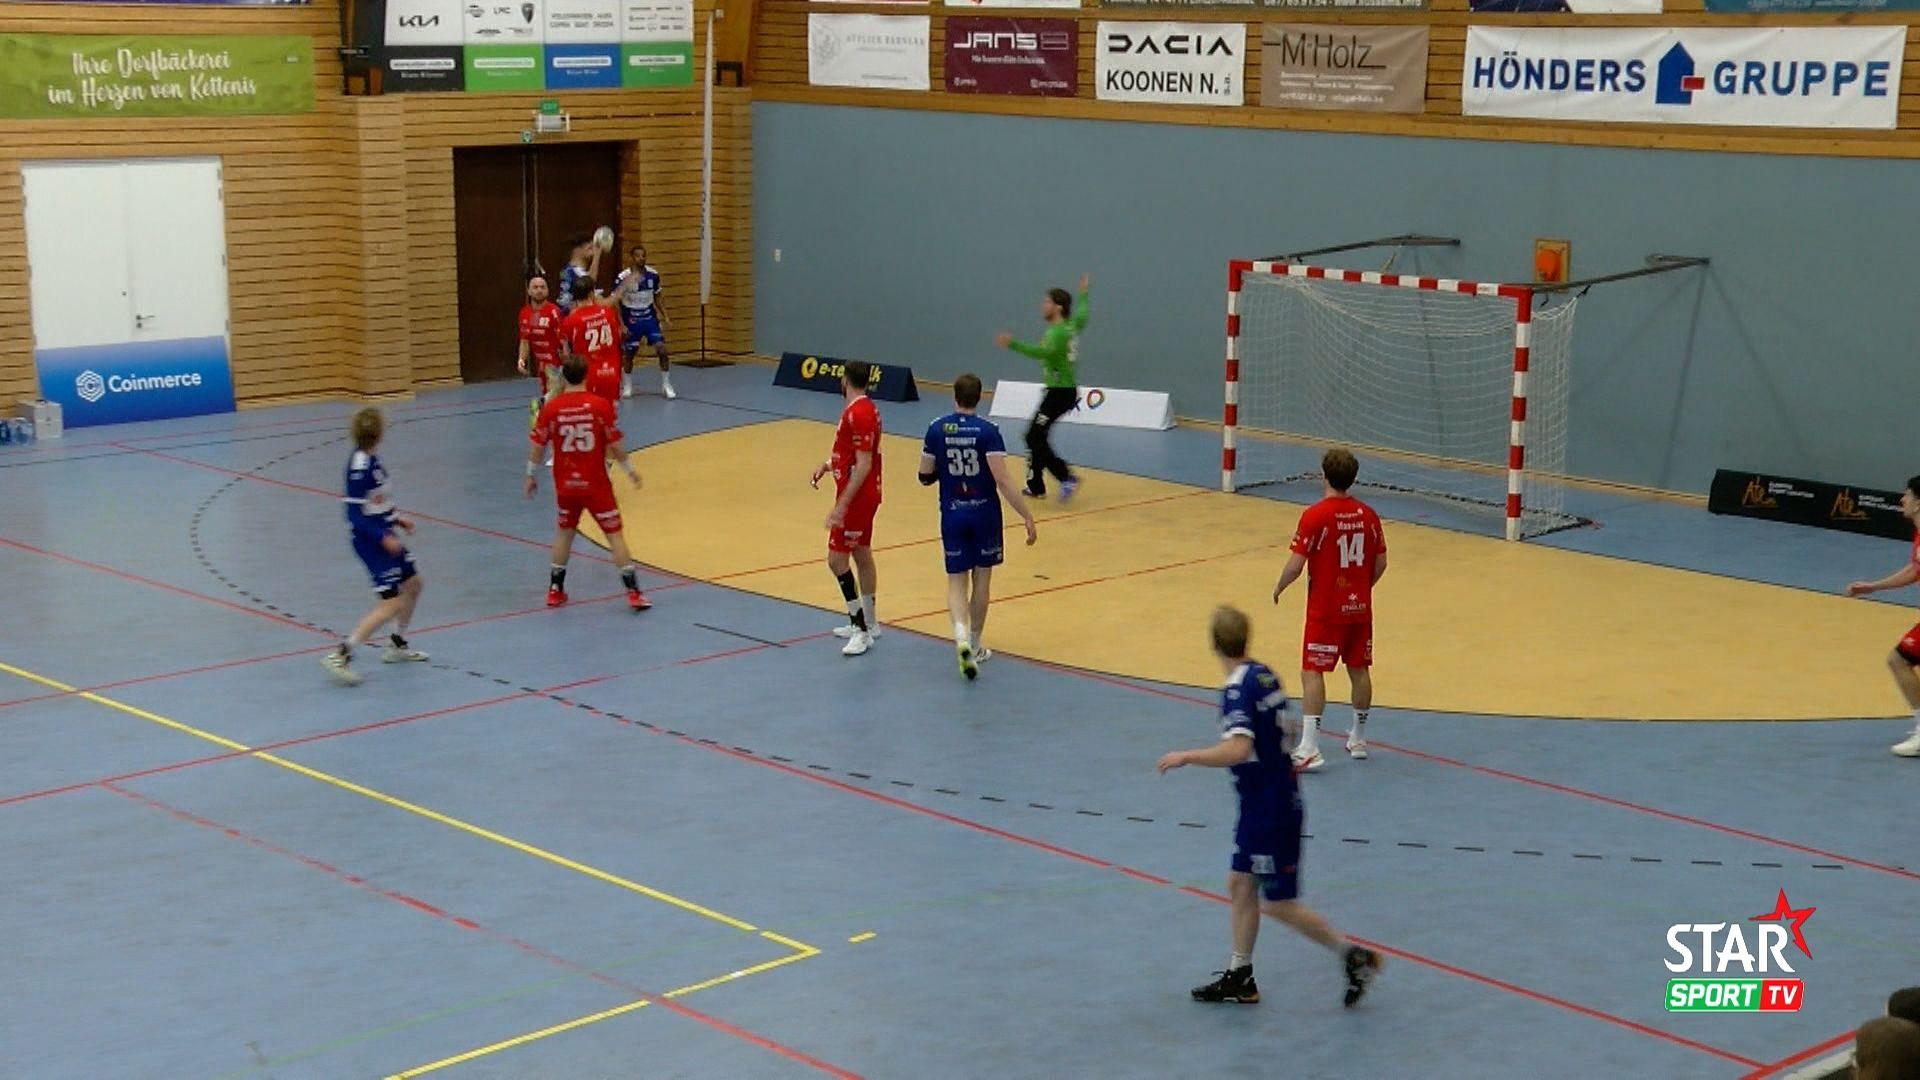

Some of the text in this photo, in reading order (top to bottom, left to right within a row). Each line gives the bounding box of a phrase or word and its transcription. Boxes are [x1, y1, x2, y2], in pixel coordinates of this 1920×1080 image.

[953, 32, 1038, 50] JANS
[1108, 34, 1233, 56] DACIA
[72, 48, 231, 80] Ihre Dorfbäckerei
[1473, 51, 1890, 97] HÖNDERS GRUPPE
[48, 73, 257, 110] im Herzen von Kettenis
[1106, 69, 1193, 93] KOONEN
[1200, 72, 1219, 94] N.
[585, 325, 613, 352] 24
[108, 372, 202, 394] Coinmerce
[560, 422, 595, 452] 25
[946, 448, 980, 477] 33
[1337, 533, 1365, 568] 14
